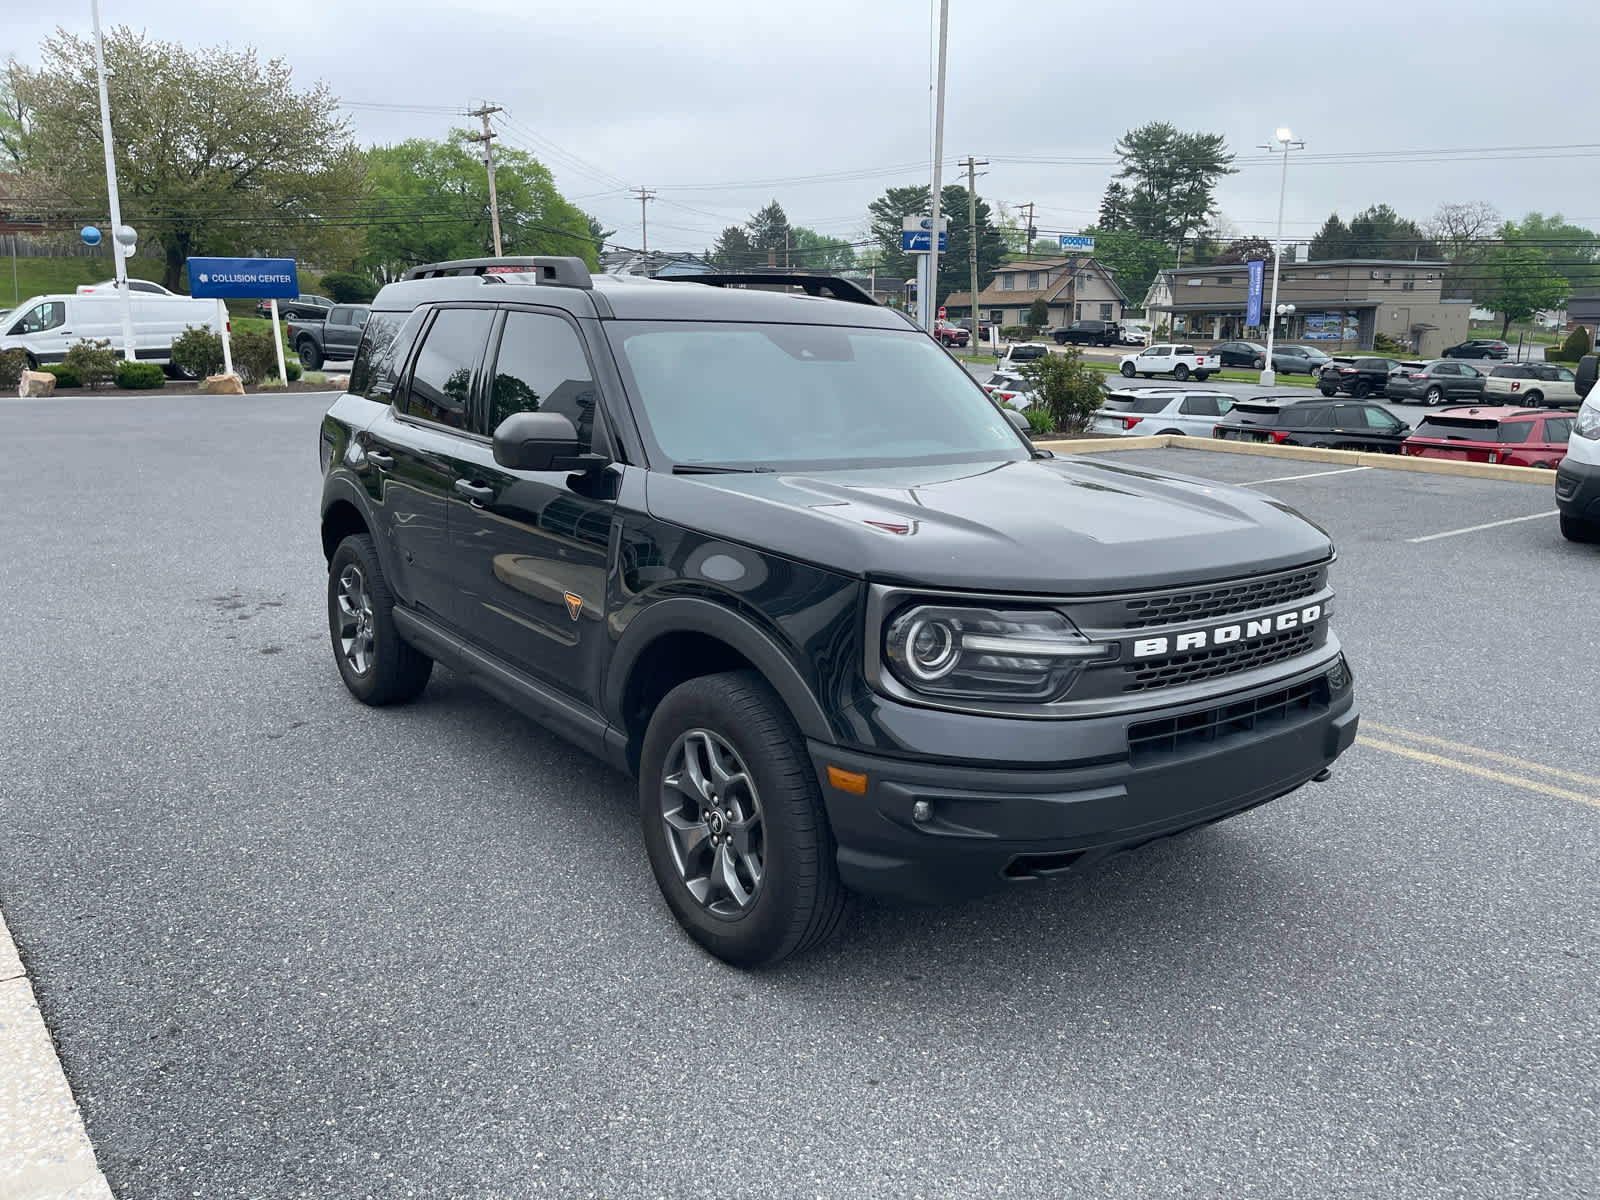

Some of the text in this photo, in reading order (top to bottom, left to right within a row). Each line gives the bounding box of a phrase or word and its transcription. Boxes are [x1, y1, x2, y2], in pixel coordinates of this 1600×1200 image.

[211, 273, 292, 283] COLLISION CENTER
[1133, 605, 1321, 657] BRONCO
